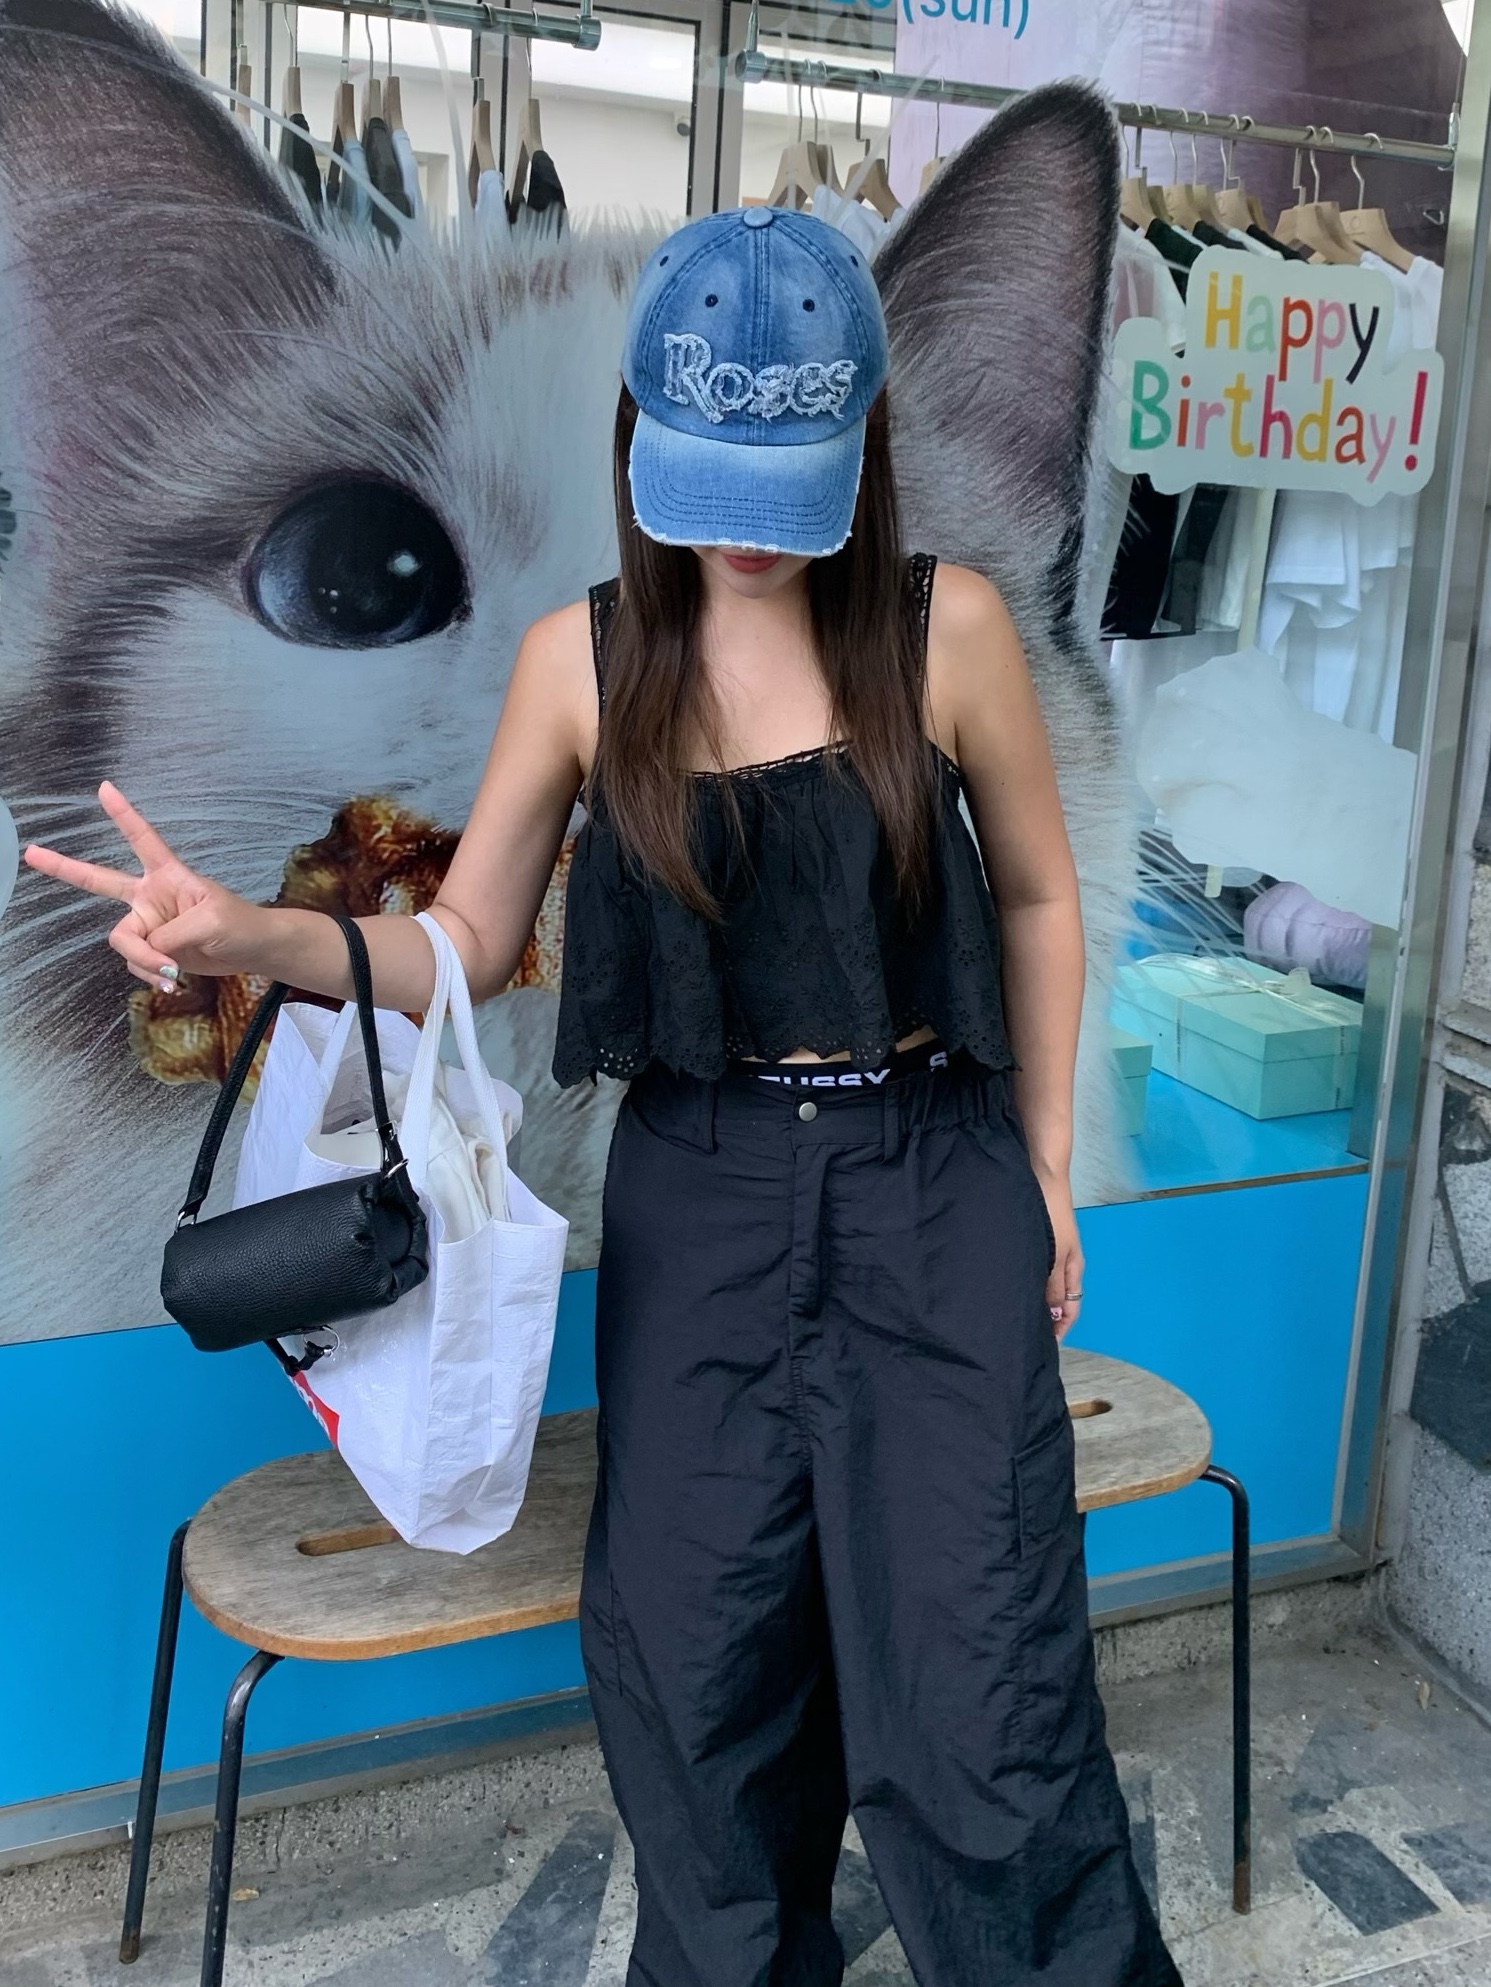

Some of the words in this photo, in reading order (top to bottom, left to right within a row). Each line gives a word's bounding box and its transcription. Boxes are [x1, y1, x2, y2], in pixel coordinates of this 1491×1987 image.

[663, 333, 859, 424] Roses
[1204, 271, 1380, 385] Happy
[1129, 360, 1429, 483] Birthday!
